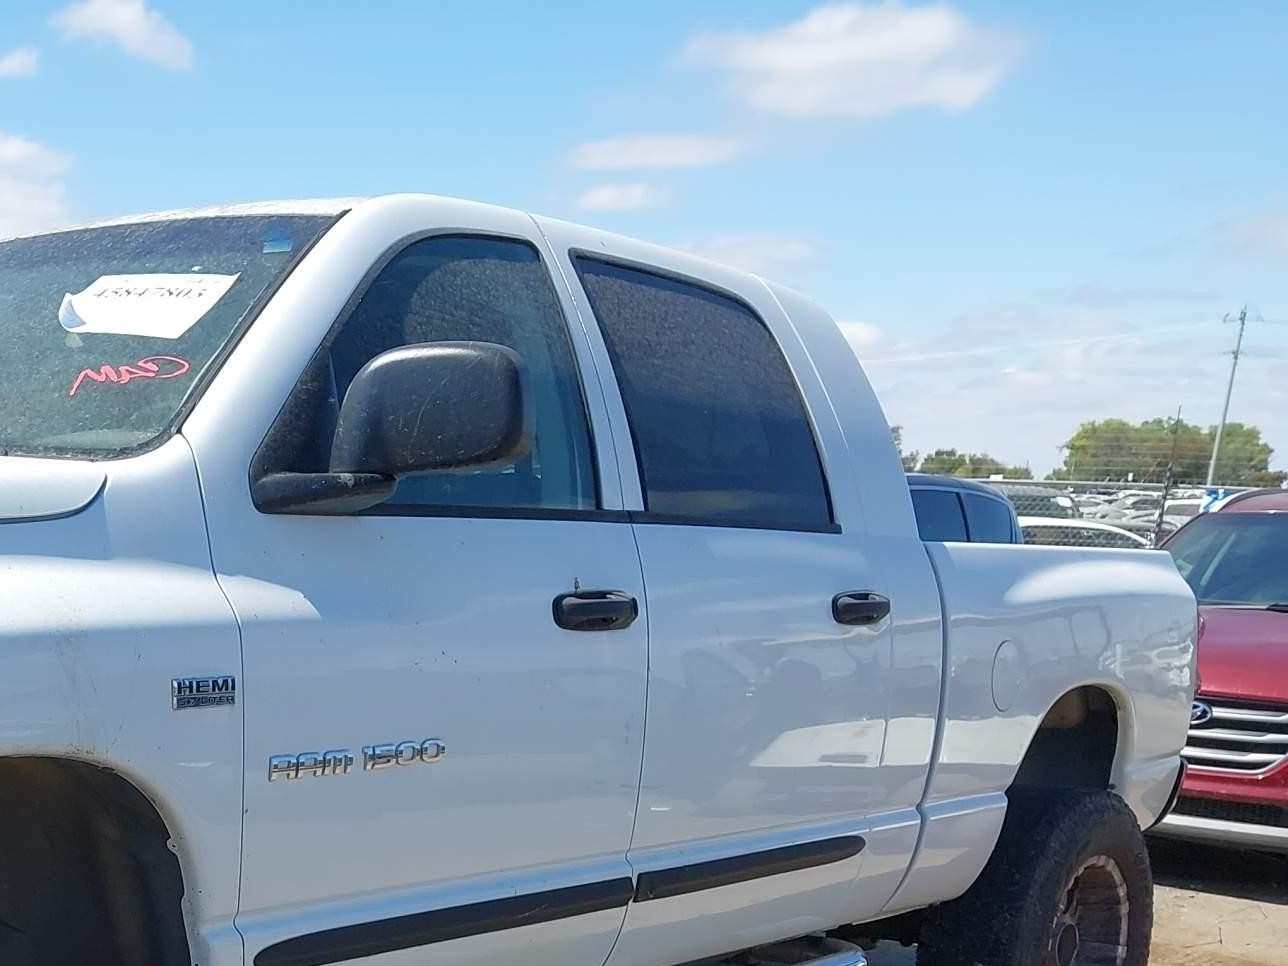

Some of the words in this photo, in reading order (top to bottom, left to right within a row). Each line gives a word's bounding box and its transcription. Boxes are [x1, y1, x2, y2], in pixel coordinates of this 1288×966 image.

[177, 679, 236, 695] HEMI
[268, 749, 354, 782] RAM
[362, 738, 446, 771] 1500
